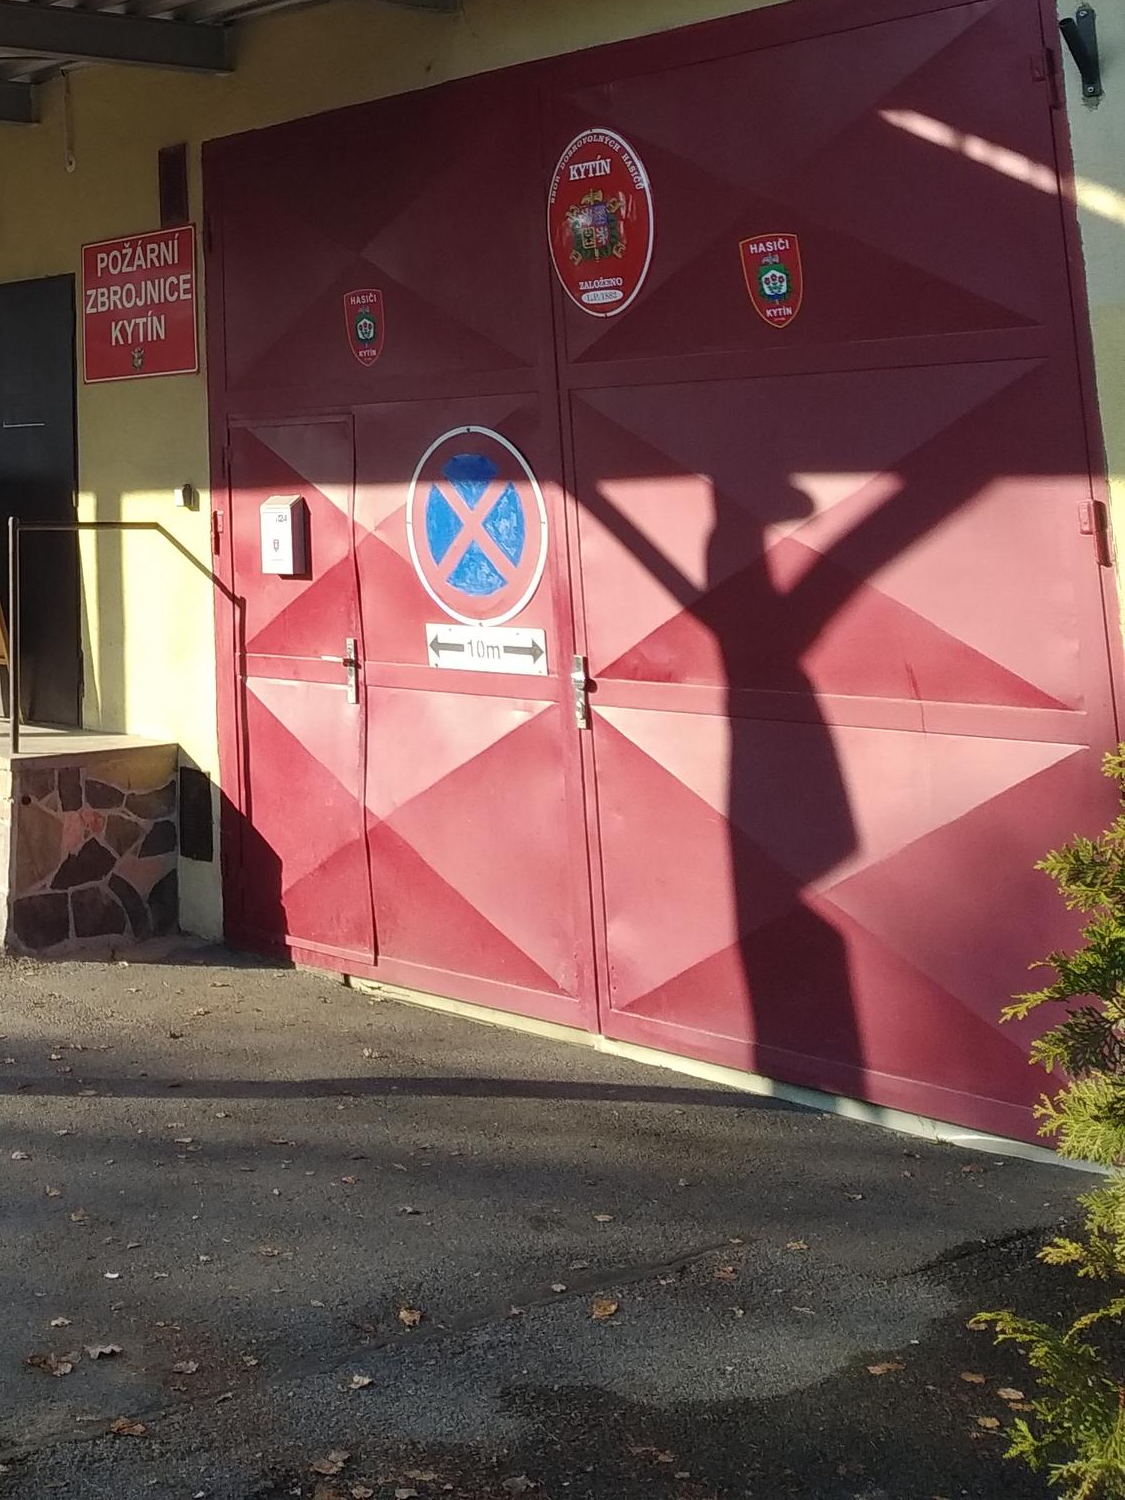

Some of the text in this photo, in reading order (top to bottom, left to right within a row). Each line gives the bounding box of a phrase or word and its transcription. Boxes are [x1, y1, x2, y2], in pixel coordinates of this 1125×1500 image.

[568, 154, 612, 181] KYTÍN
[97, 233, 180, 277] POŽÁRNÍ
[749, 238, 790, 254] HASIČI
[578, 276, 623, 290] ZALOŽENO
[86, 274, 192, 314] ZBROJNICE
[350, 292, 377, 305] HASIČI
[766, 306, 793, 318] KYTÍN
[111, 310, 166, 346] KYTÍN
[466, 639, 502, 660] 10m
